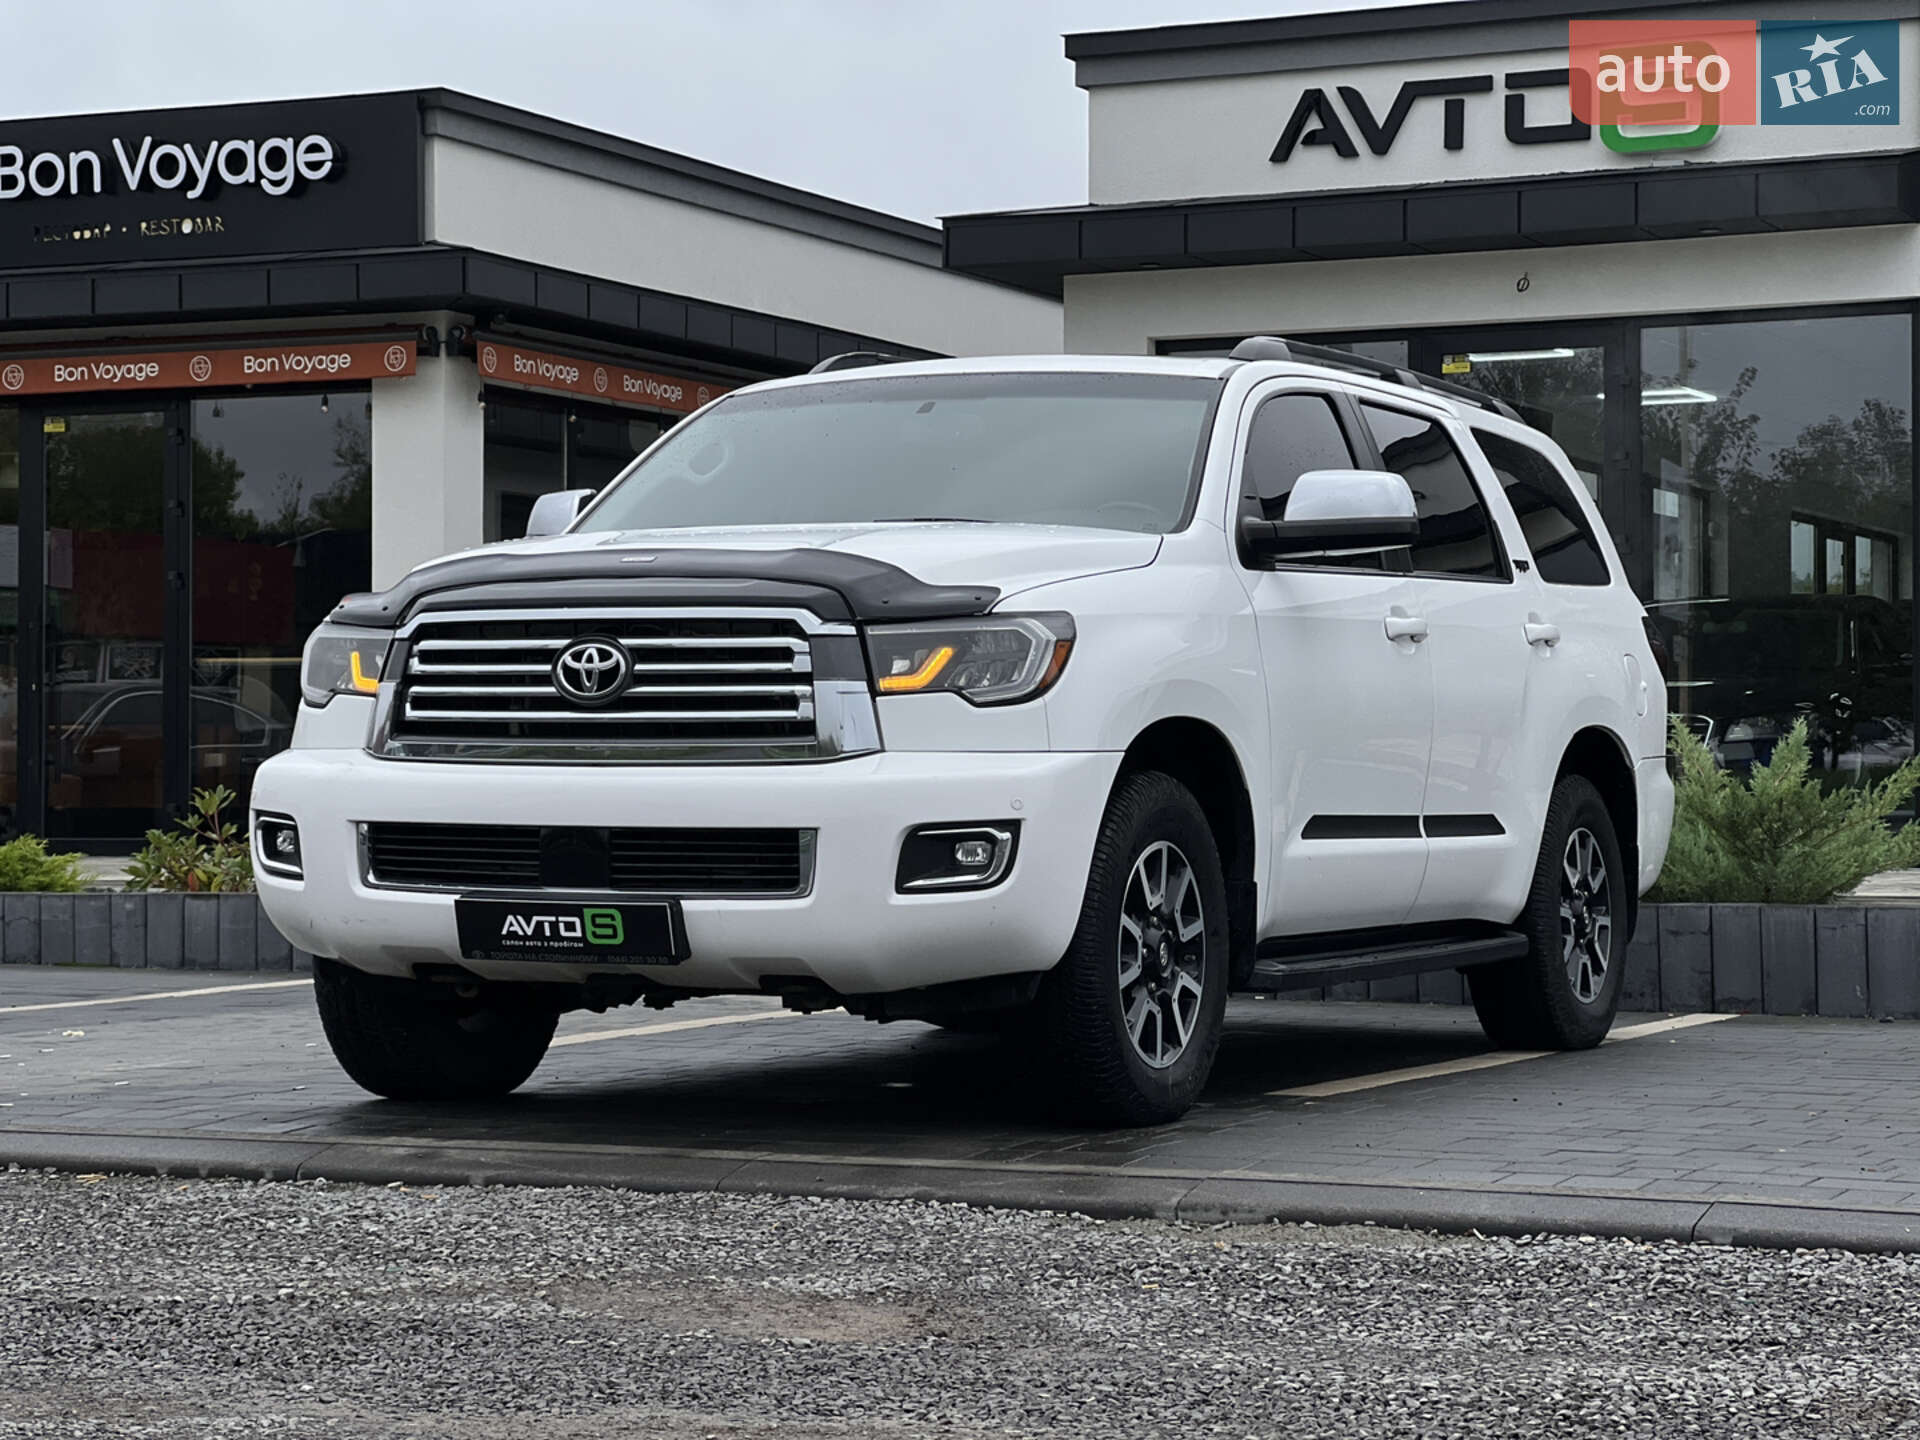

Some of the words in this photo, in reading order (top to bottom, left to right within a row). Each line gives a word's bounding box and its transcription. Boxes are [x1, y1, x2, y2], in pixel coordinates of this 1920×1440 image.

[0, 145, 101, 199] Bon
[112, 134, 334, 199] Voyage
[140, 216, 225, 238] RESTOBAR
[54, 364, 90, 382] Bon
[91, 361, 160, 383] Voyage
[243, 355, 280, 374] Bon
[281, 352, 352, 374] Voyage
[513, 354, 536, 374] Bon
[536, 358, 579, 384] Voyage
[623, 375, 643, 393] Bon
[643, 378, 682, 402] Voyage
